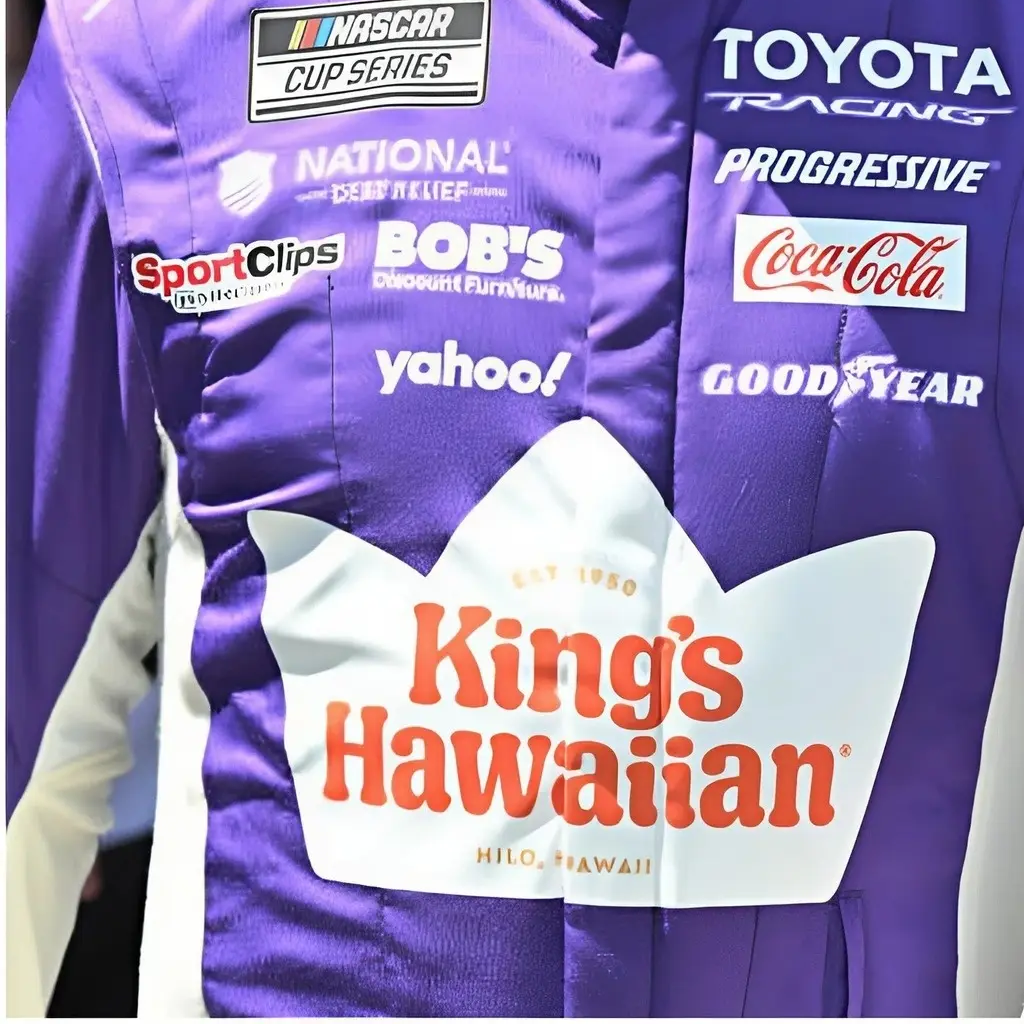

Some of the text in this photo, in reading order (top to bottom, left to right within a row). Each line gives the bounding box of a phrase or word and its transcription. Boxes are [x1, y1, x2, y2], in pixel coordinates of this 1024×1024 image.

[326, 6, 455, 47] NASCAR
[284, 52, 453, 93] CUP SERIES
[713, 27, 1012, 97] TOYOTA
[704, 91, 1018, 126] RACING
[714, 146, 990, 194] PROGRESSIVE
[135, 242, 338, 296] SportClips
[373, 220, 565, 280] BOB'S
[743, 227, 961, 299] Coca-Cola
[375, 339, 572, 397] yahoo!
[408, 601, 744, 731] King's
[322, 700, 836, 830] Hawaiian
